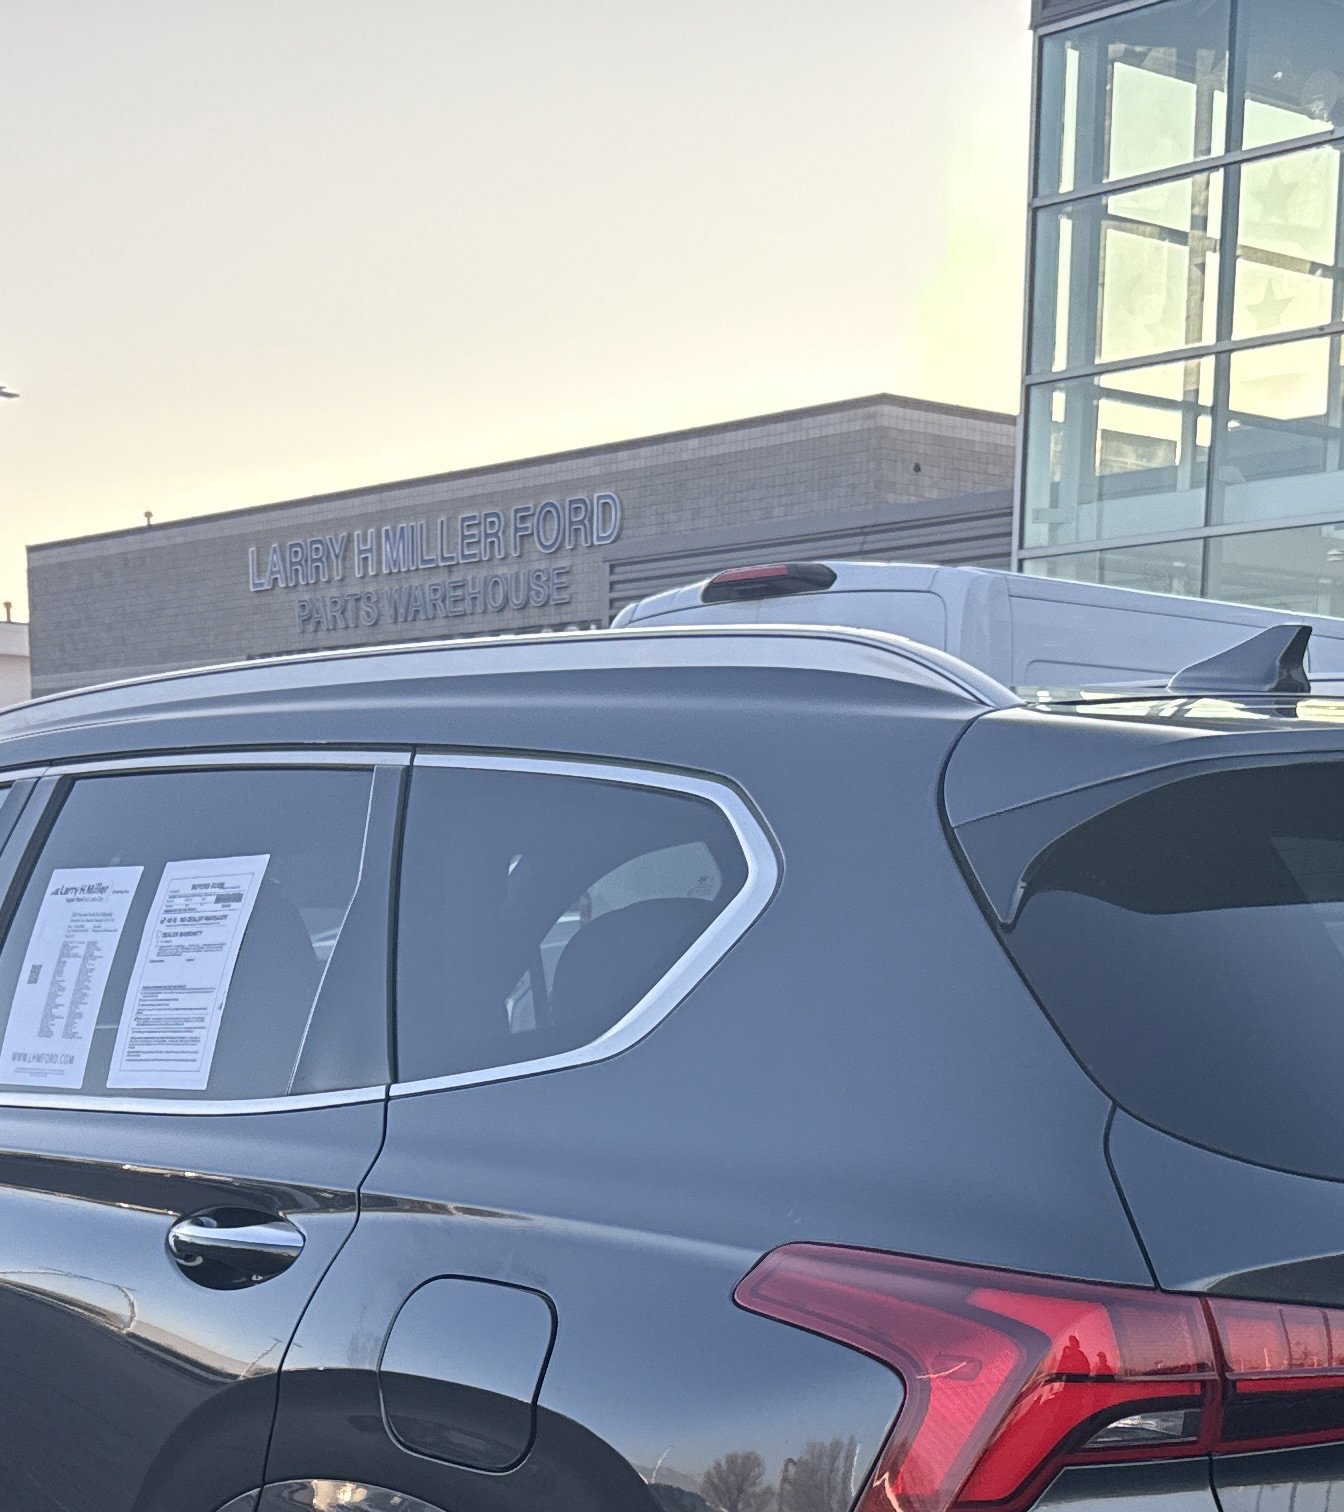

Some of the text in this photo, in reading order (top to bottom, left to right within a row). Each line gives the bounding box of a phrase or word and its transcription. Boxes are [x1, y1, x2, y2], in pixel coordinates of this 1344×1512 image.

[248, 492, 622, 591] LARRY H MILLER FORD
[297, 565, 571, 633] PARTS WAREHOUSE
